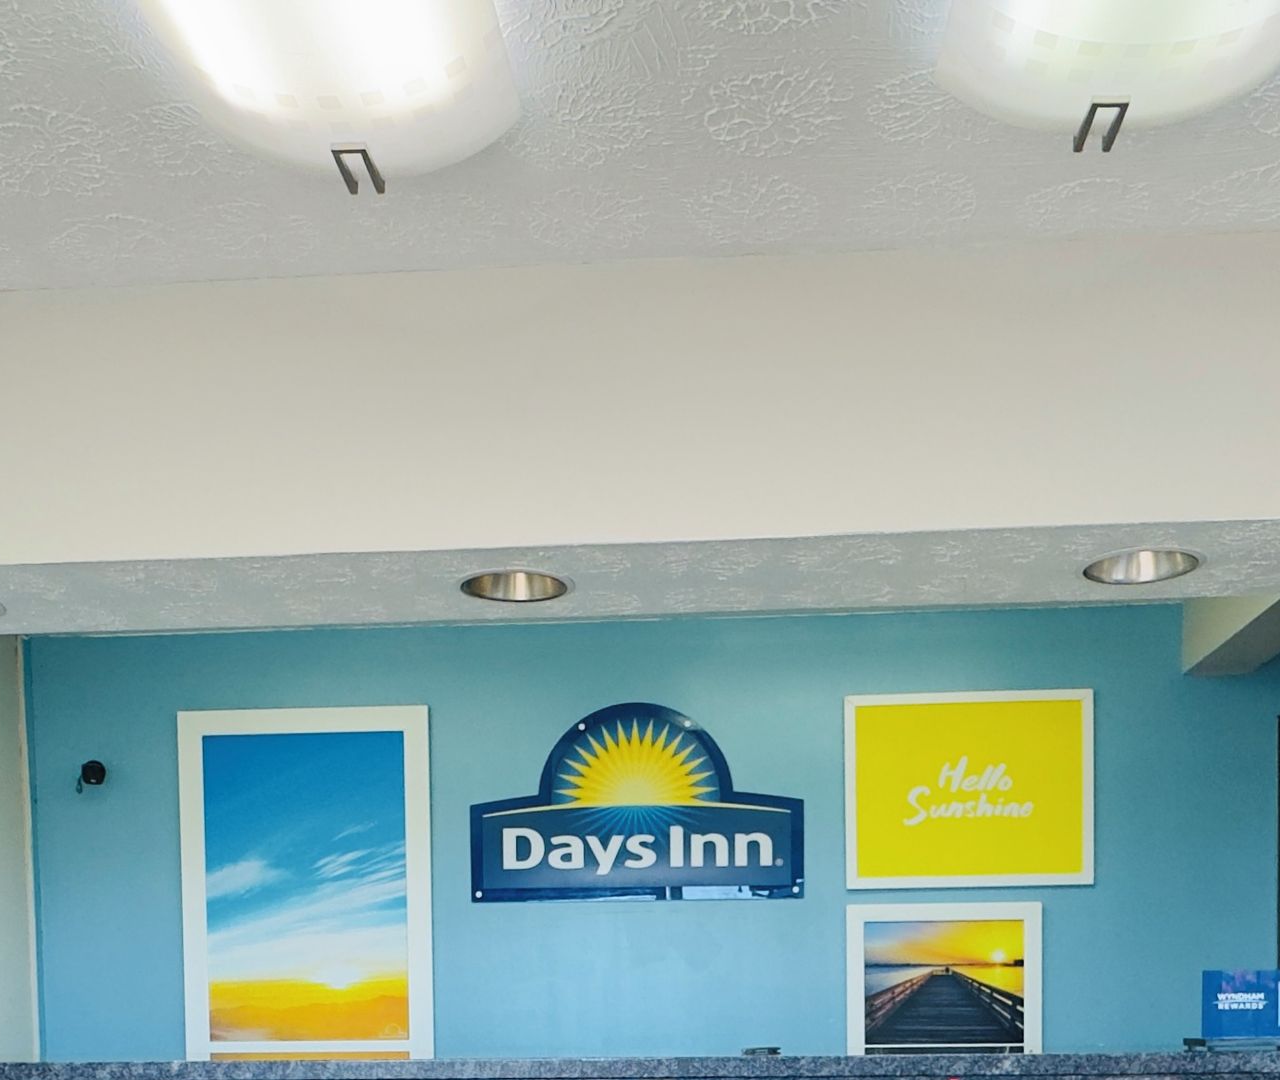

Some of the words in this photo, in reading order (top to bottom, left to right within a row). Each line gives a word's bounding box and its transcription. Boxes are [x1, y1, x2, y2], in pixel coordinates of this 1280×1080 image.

[938, 755, 1013, 792] Hello
[903, 786, 1034, 826] Sunshine
[502, 827, 657, 876] Days
[670, 825, 773, 867] Inn
